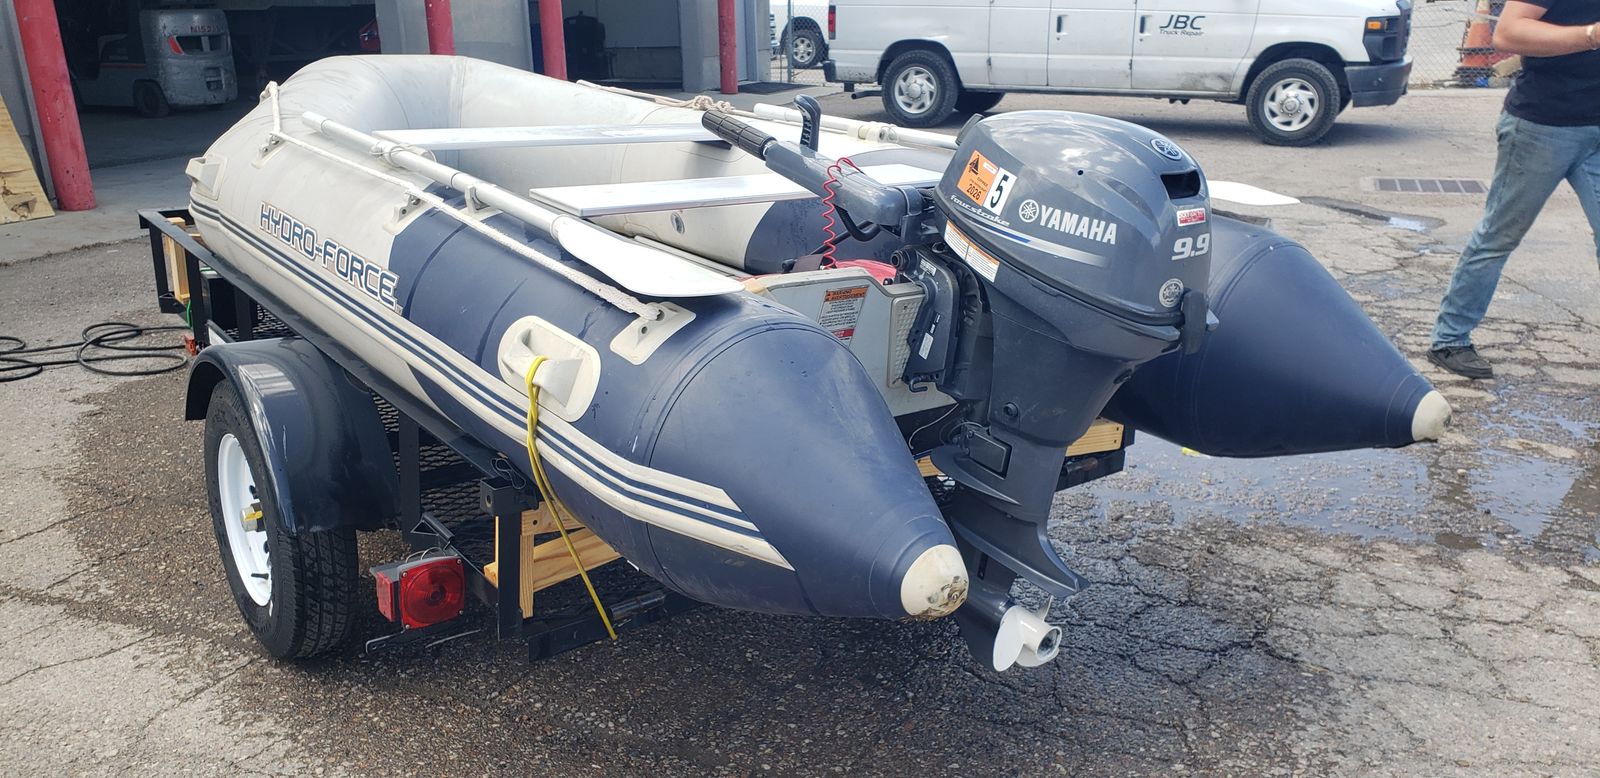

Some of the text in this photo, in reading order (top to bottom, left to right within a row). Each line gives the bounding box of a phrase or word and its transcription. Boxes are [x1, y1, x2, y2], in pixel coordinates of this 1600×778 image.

[1159, 14, 1206, 30] JBC
[966, 183, 982, 201] 2026
[990, 174, 1009, 208] 5
[1040, 204, 1117, 245] YAMAHA
[259, 201, 399, 312] HYDRO-FORCE
[1171, 233, 1210, 260] 9.9
